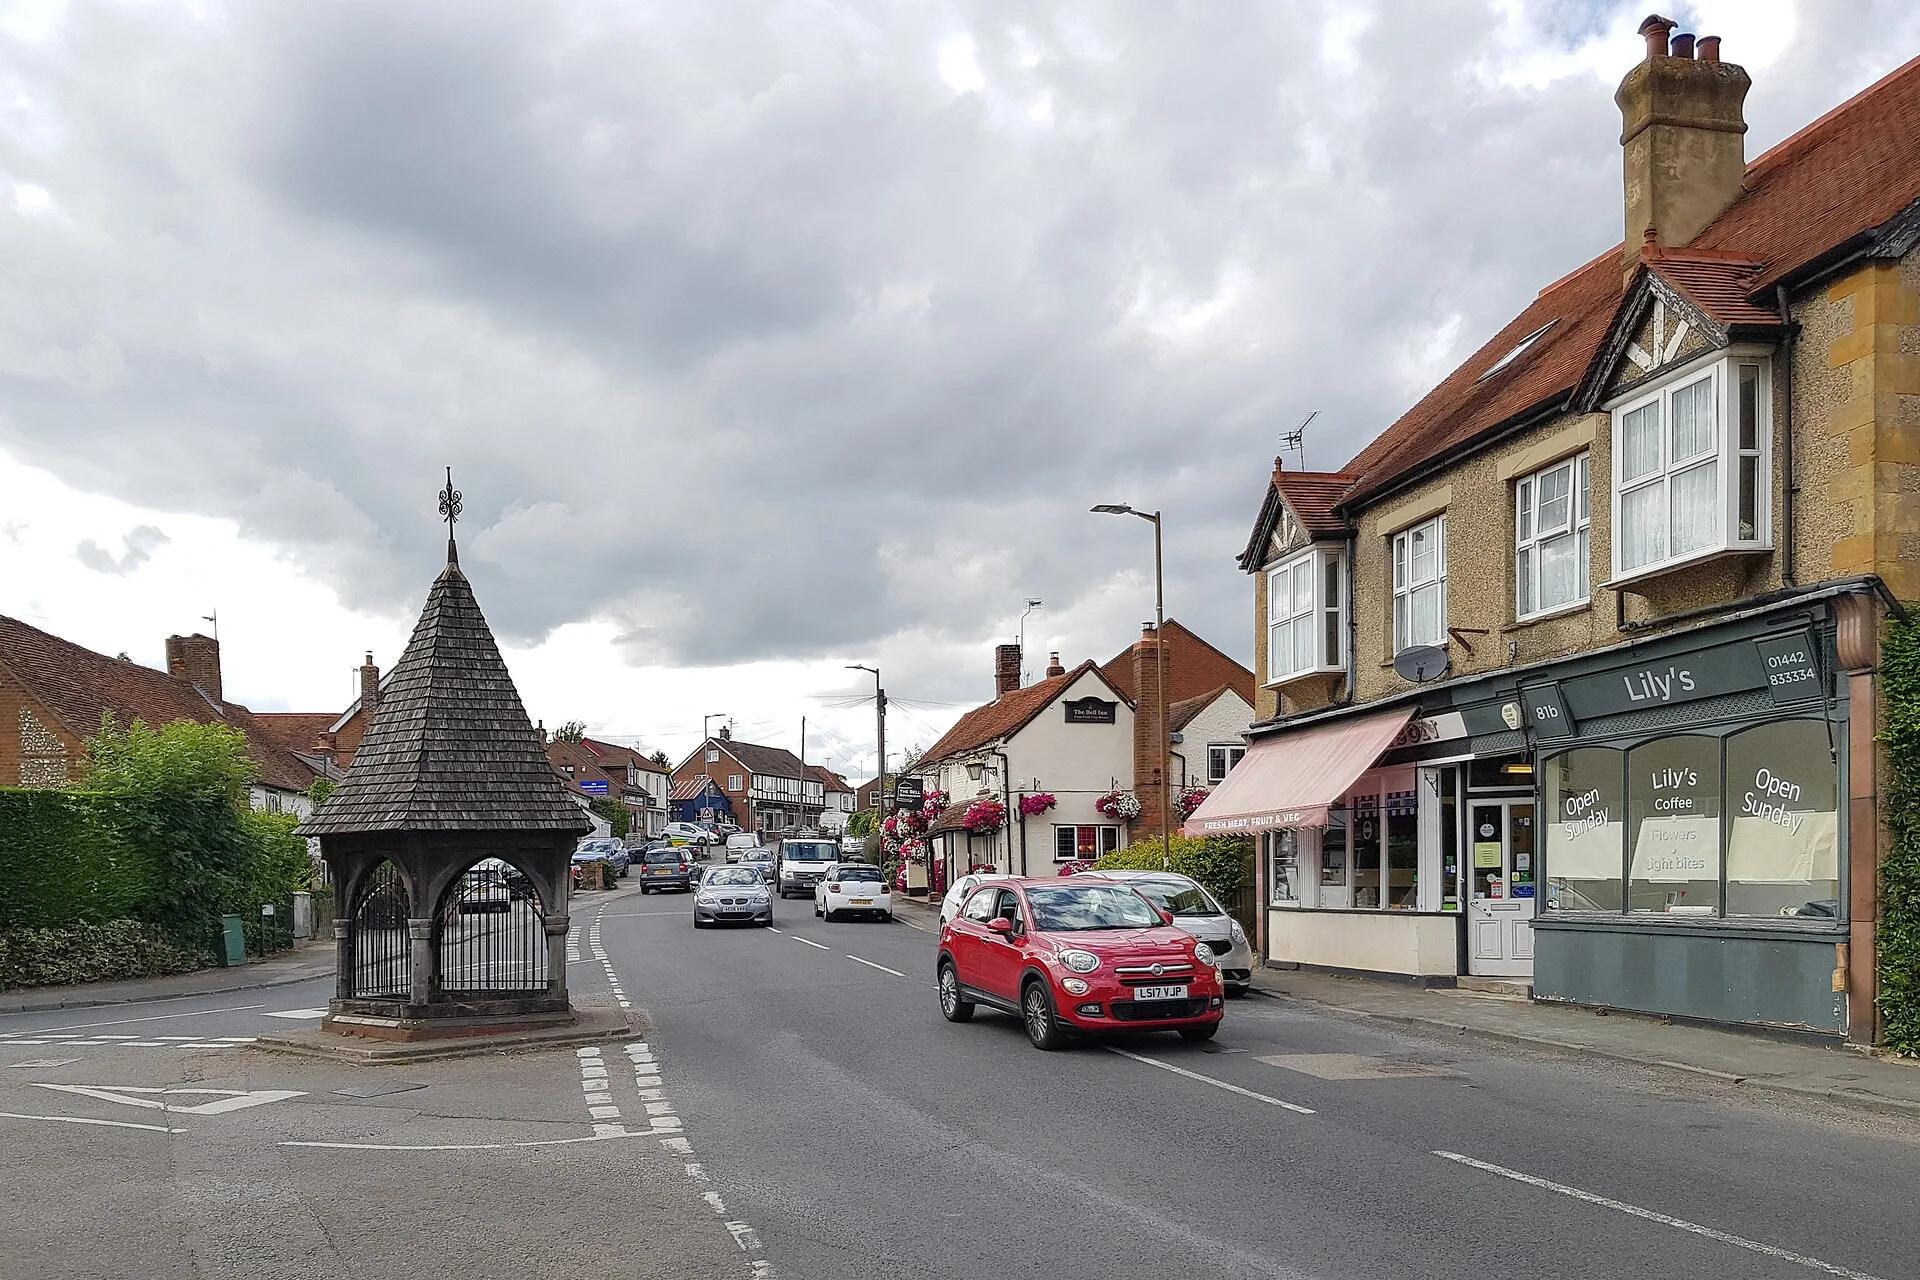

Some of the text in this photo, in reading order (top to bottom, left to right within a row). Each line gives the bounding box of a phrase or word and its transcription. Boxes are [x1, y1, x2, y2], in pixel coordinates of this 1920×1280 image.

[1767, 651, 1806, 669] 01442
[1623, 667, 1695, 701] Lily's
[1769, 667, 1815, 686] 833334
[1535, 705, 1559, 720] 81b
[1651, 767, 1698, 790] Lily's
[1755, 768, 1801, 802] Open
[1565, 788, 1600, 816] Open
[1654, 797, 1693, 811] Coffee
[1204, 812, 1300, 830] FRESH MEAT, FRUIT & VEG
[1741, 791, 1804, 837] Sunday
[1564, 806, 1609, 841] Sunday
[1651, 828, 1697, 842] Flowers
[1675, 856, 1705, 870] bites
[1140, 987, 1182, 998] LS17 VJP
